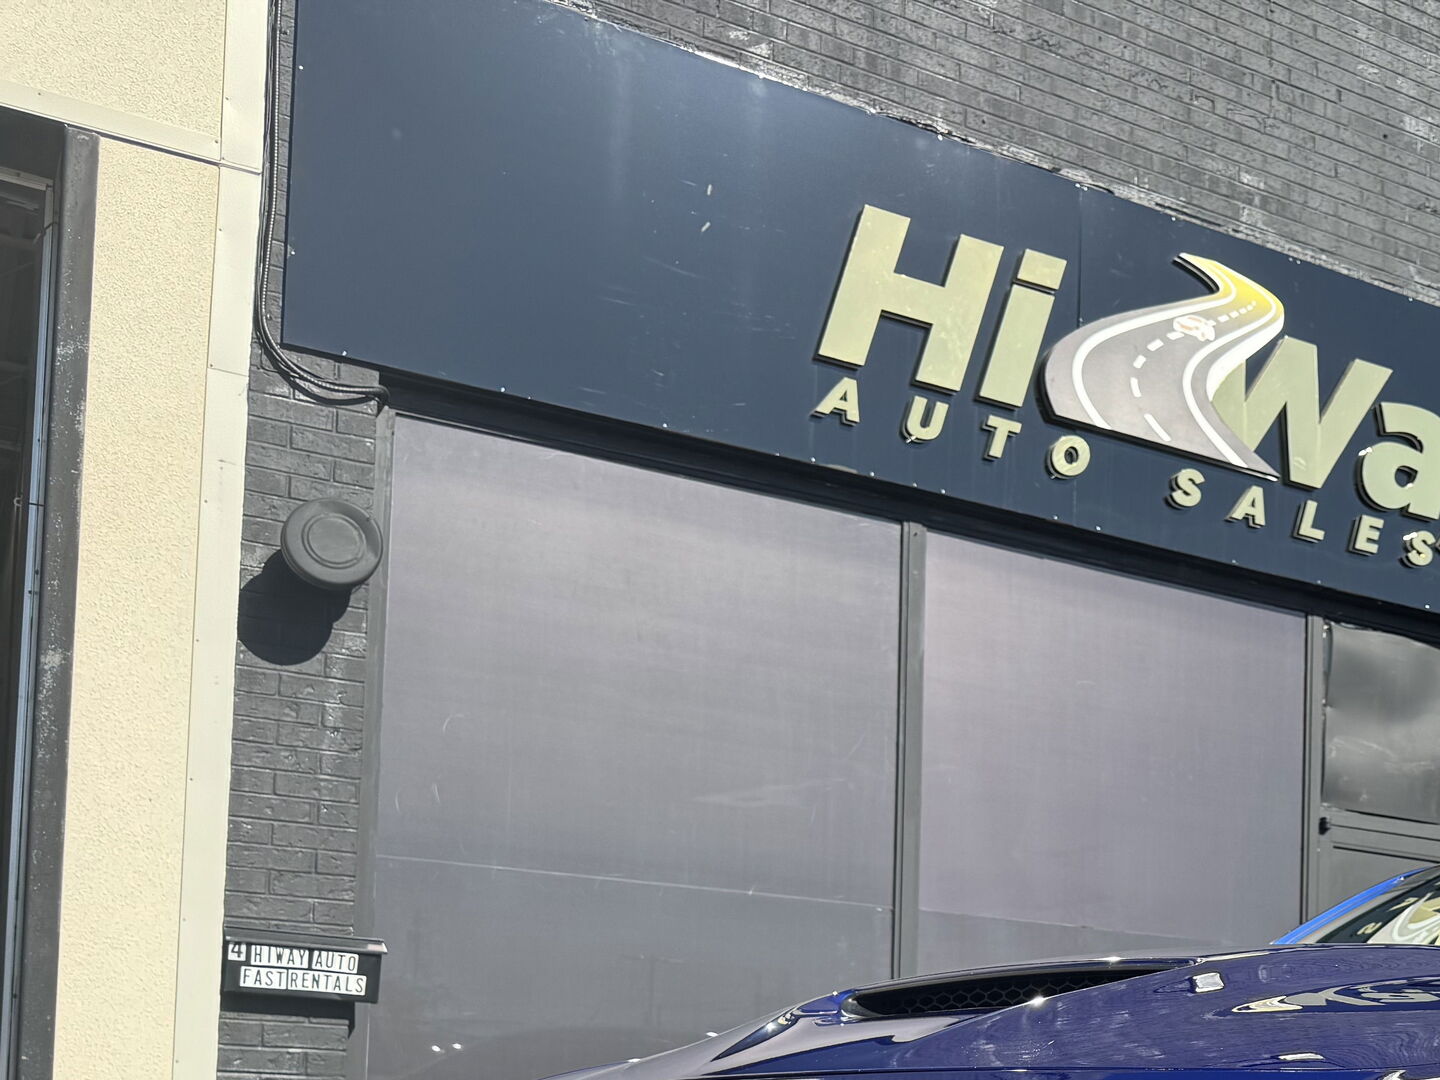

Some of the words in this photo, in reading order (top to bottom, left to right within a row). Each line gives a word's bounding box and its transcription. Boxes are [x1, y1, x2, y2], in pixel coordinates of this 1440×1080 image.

[814, 377, 1092, 478] AUTO
[1168, 468, 1433, 567] SALES
[230, 942, 244, 959] 4
[253, 945, 306, 966] HIWAY
[314, 950, 357, 972] AUTO
[242, 968, 287, 987] FAST
[289, 972, 364, 994] RENTALS
